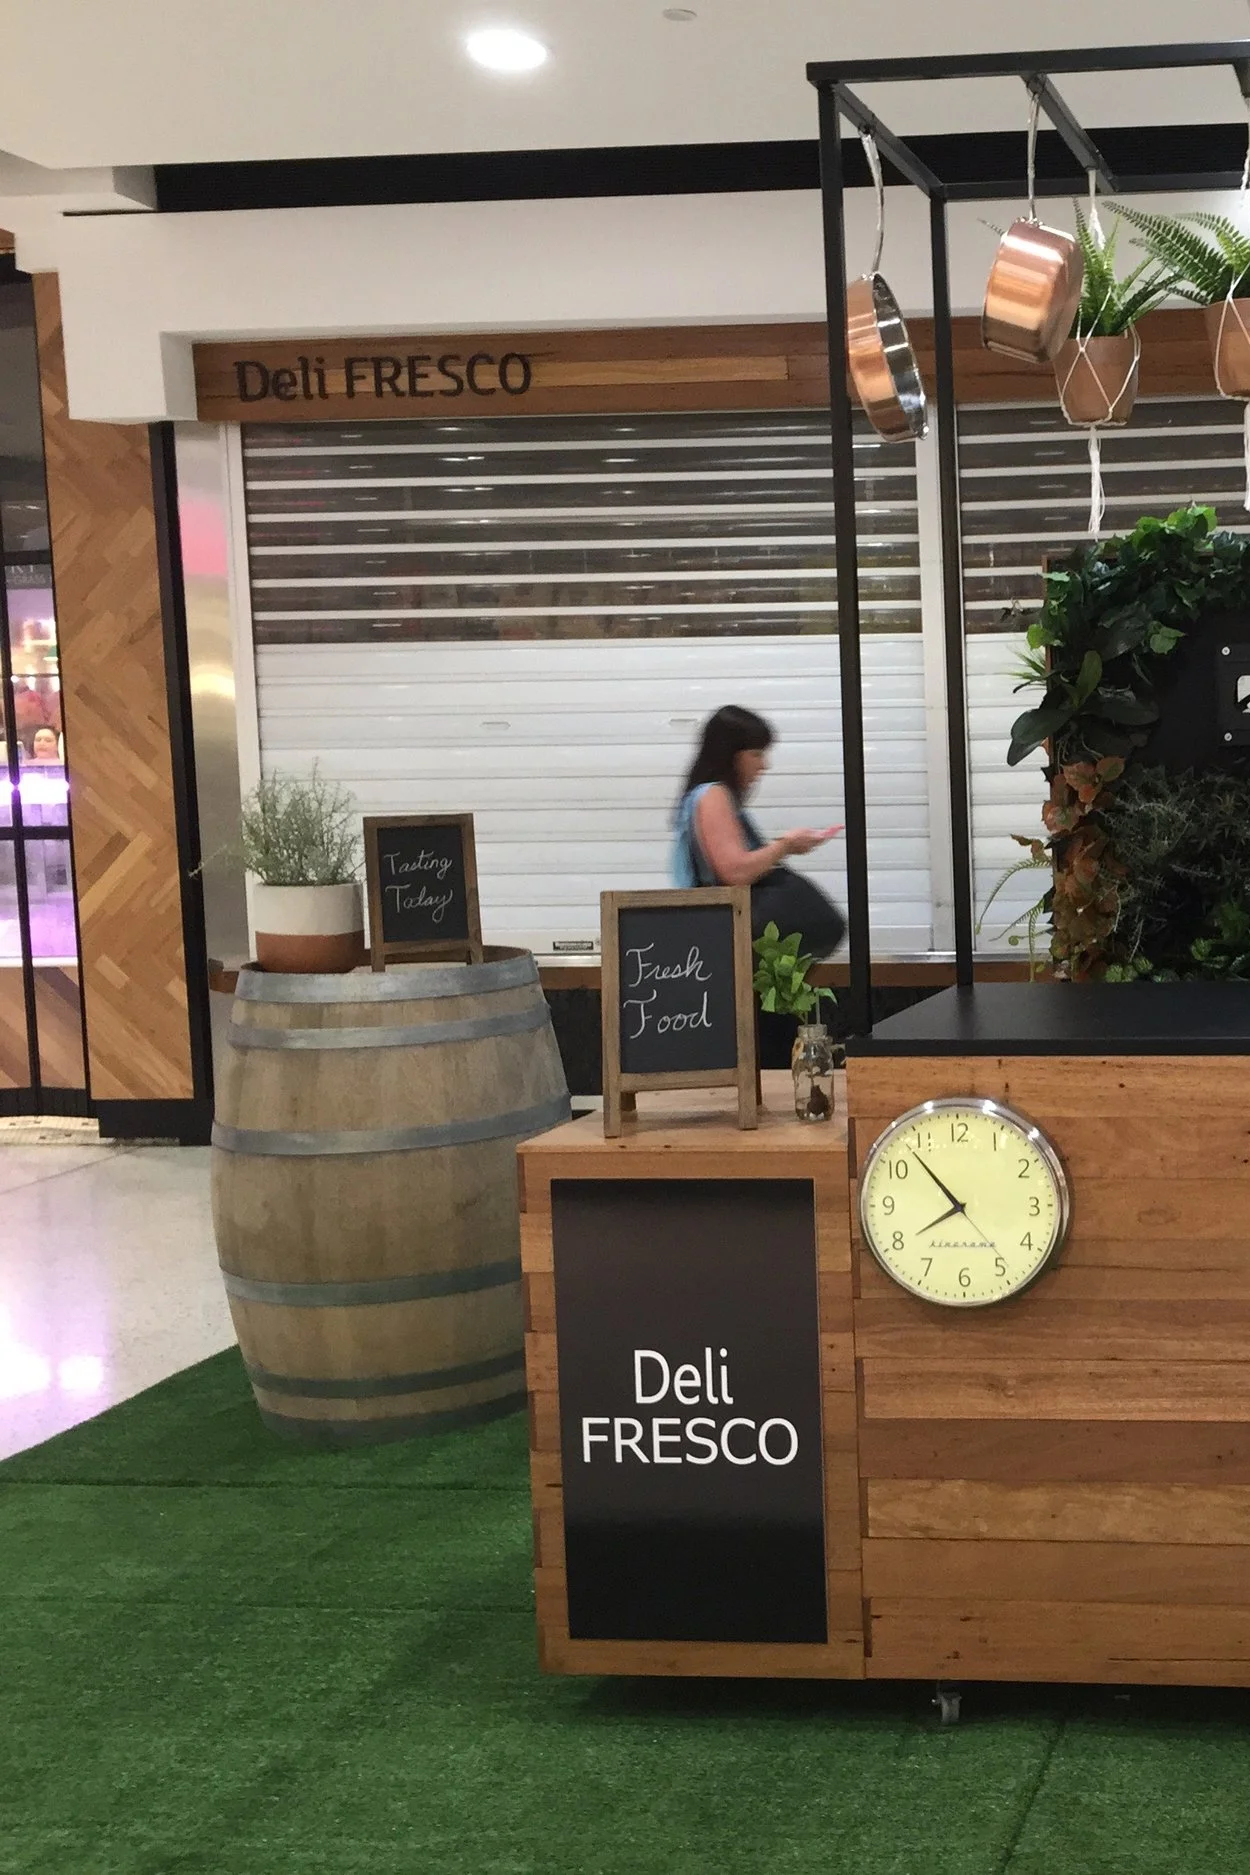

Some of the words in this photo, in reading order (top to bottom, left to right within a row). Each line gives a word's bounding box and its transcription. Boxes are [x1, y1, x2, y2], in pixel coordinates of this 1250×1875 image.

[233, 356, 329, 402] Deli
[344, 352, 532, 400] FRESCO
[383, 849, 453, 880] Tasting
[384, 885, 453, 924] Today
[625, 942, 713, 987] Fresh
[622, 988, 713, 1039] Food
[951, 1123, 969, 1142] 12
[888, 1160, 909, 1179] 10
[1018, 1158, 1030, 1178] 2
[882, 1195, 895, 1216] 9
[1028, 1196, 1041, 1217] 3
[892, 1231, 905, 1250] 8
[1019, 1231, 1034, 1251] 4
[920, 1257, 933, 1277] 7
[958, 1267, 971, 1288] 6
[994, 1257, 1007, 1277] 5
[634, 1347, 734, 1405] Deli
[582, 1417, 799, 1466] FRESCO
